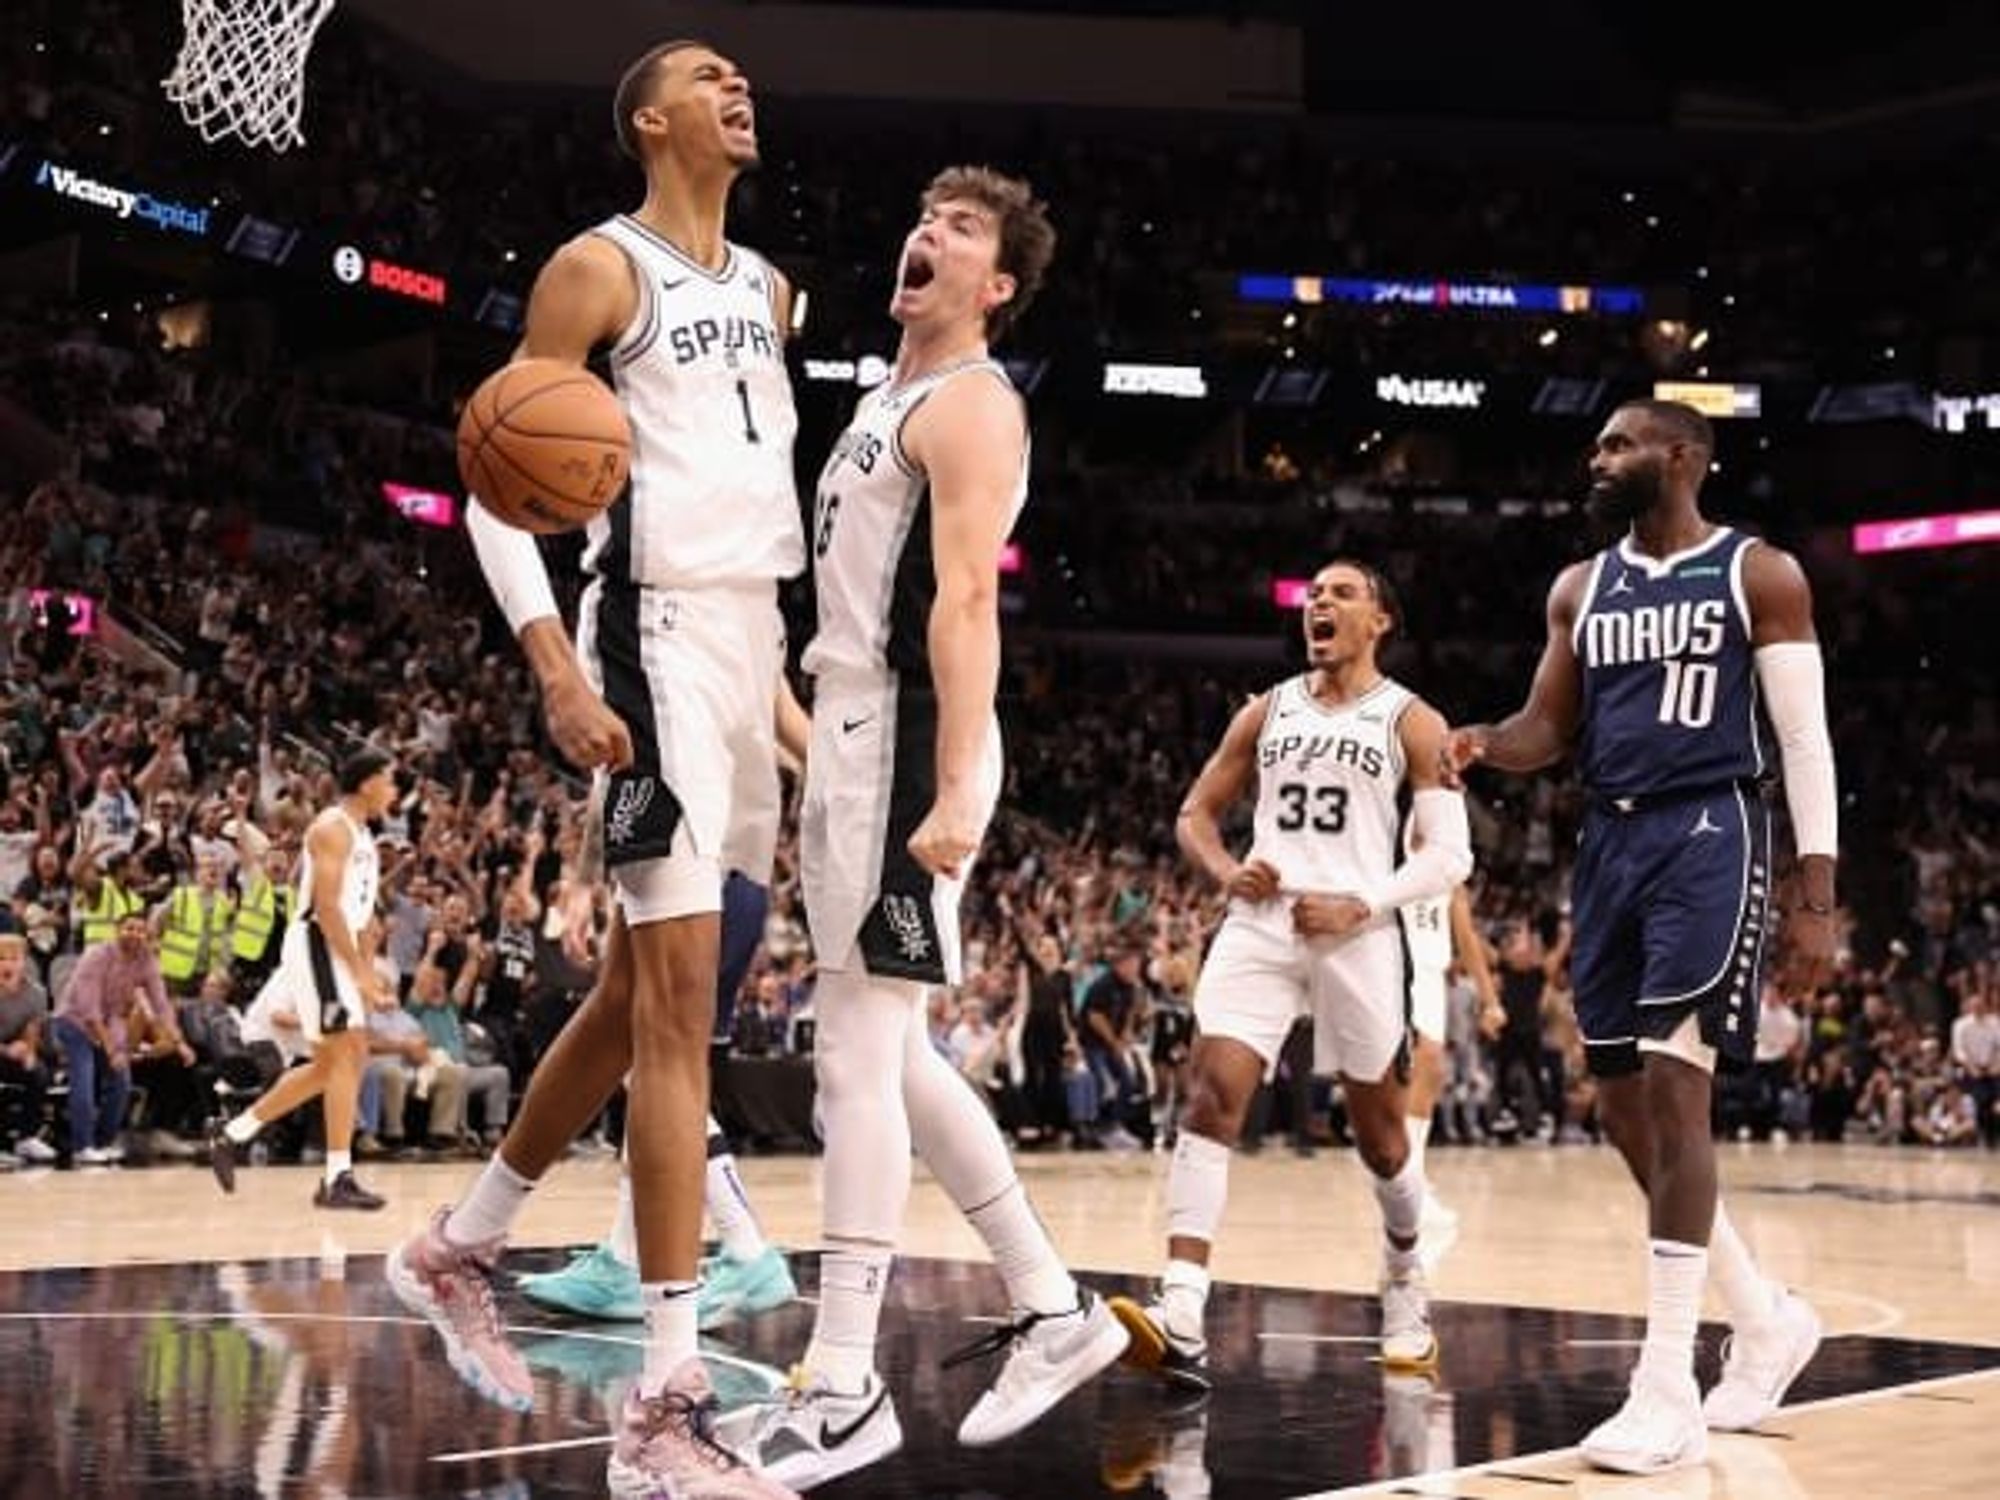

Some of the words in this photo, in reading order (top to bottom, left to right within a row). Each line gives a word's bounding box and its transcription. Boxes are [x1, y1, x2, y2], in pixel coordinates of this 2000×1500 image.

[370, 260, 445, 304] BOSCH
[1451, 284, 1517, 306] ULTRA
[736, 379, 760, 444] 1
[1586, 600, 1725, 668] MAVS
[1658, 660, 1719, 728] 10
[1262, 735, 1385, 778] SPURS
[1276, 782, 1348, 835] 33
